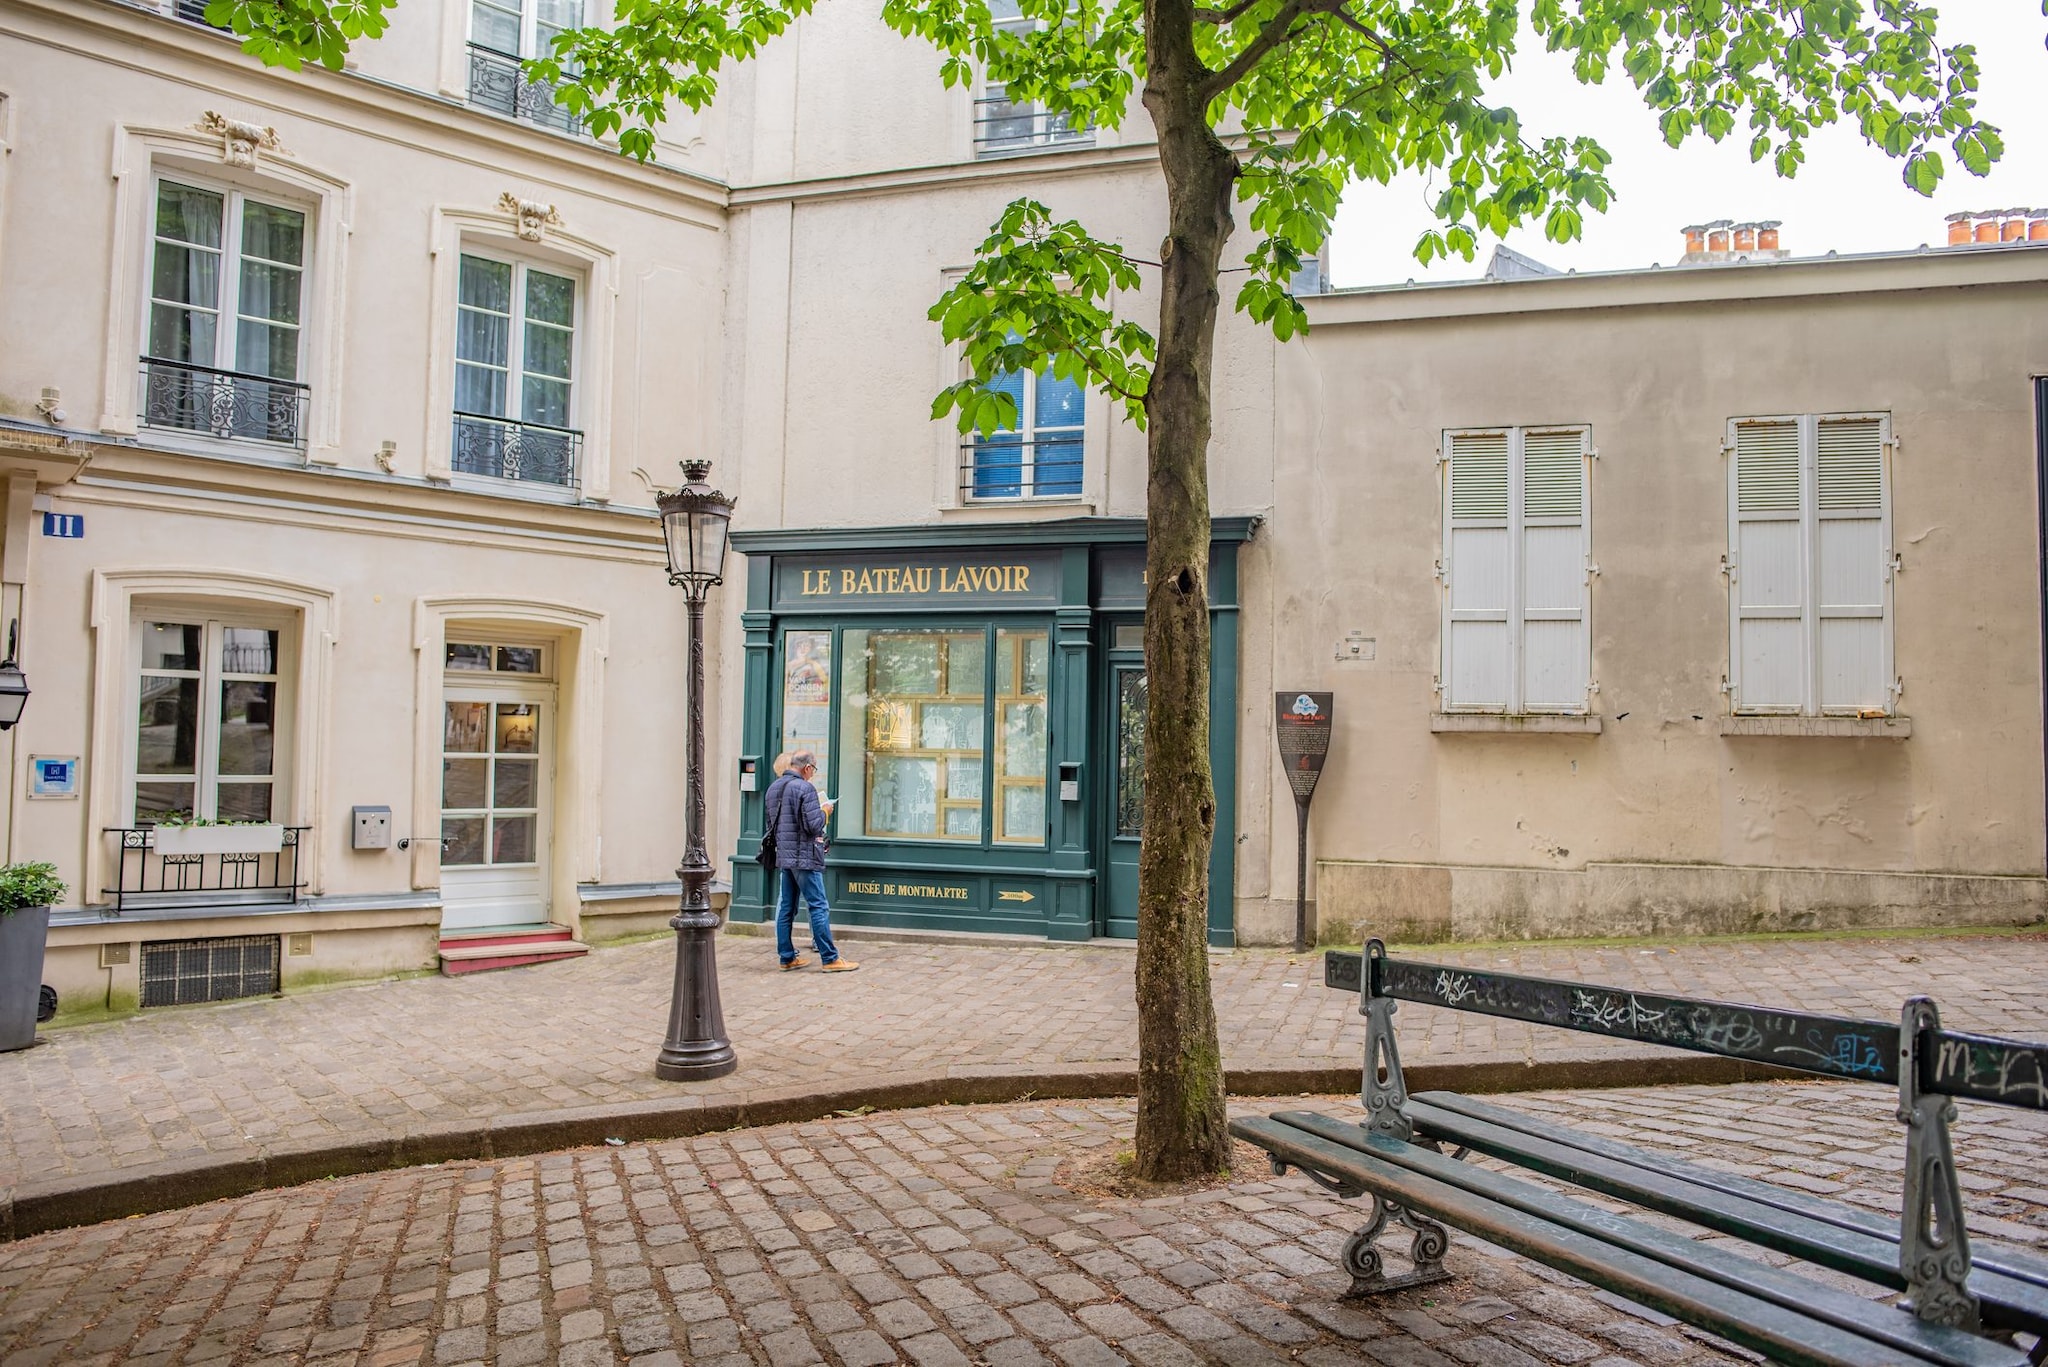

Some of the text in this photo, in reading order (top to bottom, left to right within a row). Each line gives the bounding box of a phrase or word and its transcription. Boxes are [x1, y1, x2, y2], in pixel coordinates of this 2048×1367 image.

[53, 515, 74, 536] 11
[801, 565, 1030, 595] LE BATEAU LAVOIR
[848, 879, 968, 899] MUSÉE DE MONTMARTRE
